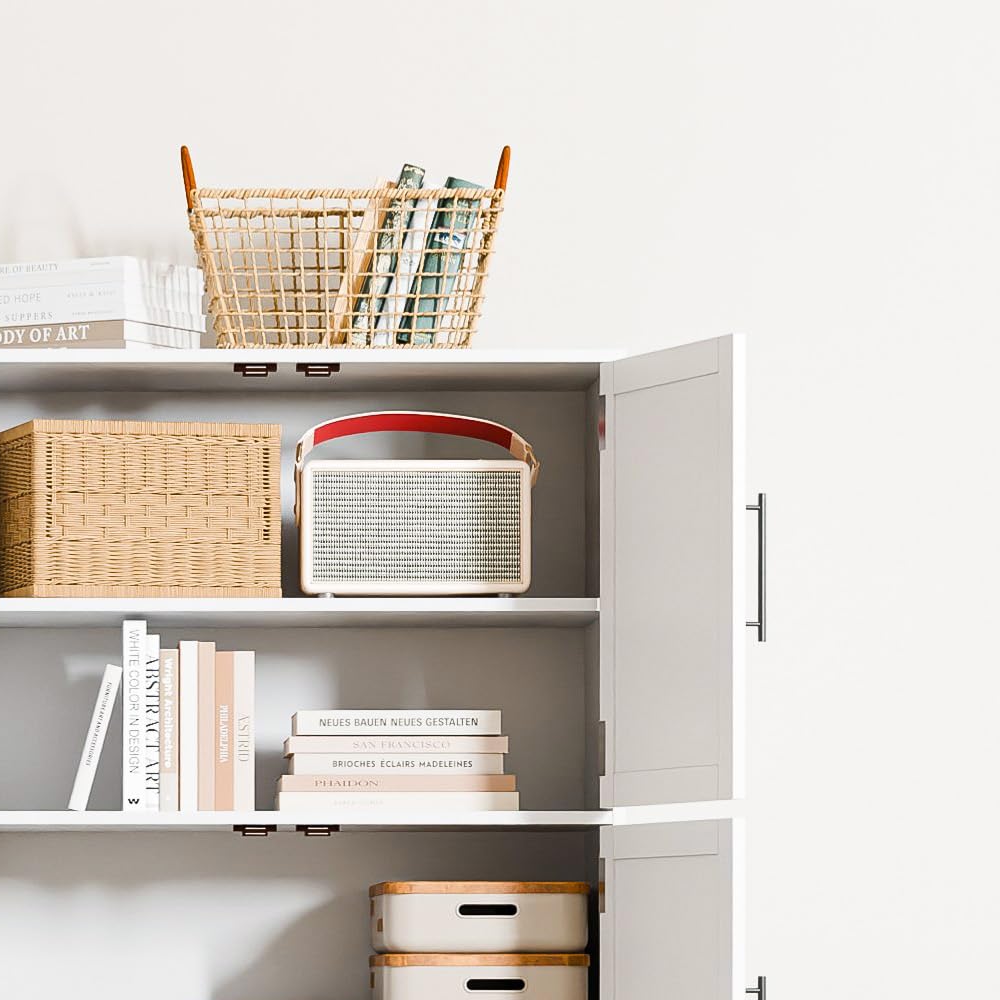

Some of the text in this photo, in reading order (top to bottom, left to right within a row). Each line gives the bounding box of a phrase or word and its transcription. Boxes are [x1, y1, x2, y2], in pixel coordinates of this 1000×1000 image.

[11, 265, 23, 274] OF
[25, 263, 59, 273] BEAUTY
[14, 292, 41, 304] HOPE
[4, 311, 54, 322] SUPPERS
[29, 327, 52, 343] OF
[55, 324, 90, 341] ART
[128, 629, 140, 774] WHITE COLOR IN DESIGN
[162, 658, 174, 768] Wright Architecture
[146, 654, 160, 794] ABSTRACT ART
[319, 717, 479, 727] NEUES BAUEN NEUES GESTALTEN
[219, 704, 228, 762] PHILADELPHIA
[238, 713, 250, 762] ASTRID
[352, 741, 451, 749] SAN FRANCISCO
[332, 760, 376, 768] BRIOCHES
[419, 760, 473, 768] MADELEINES
[314, 780, 379, 788] PHAIDON
